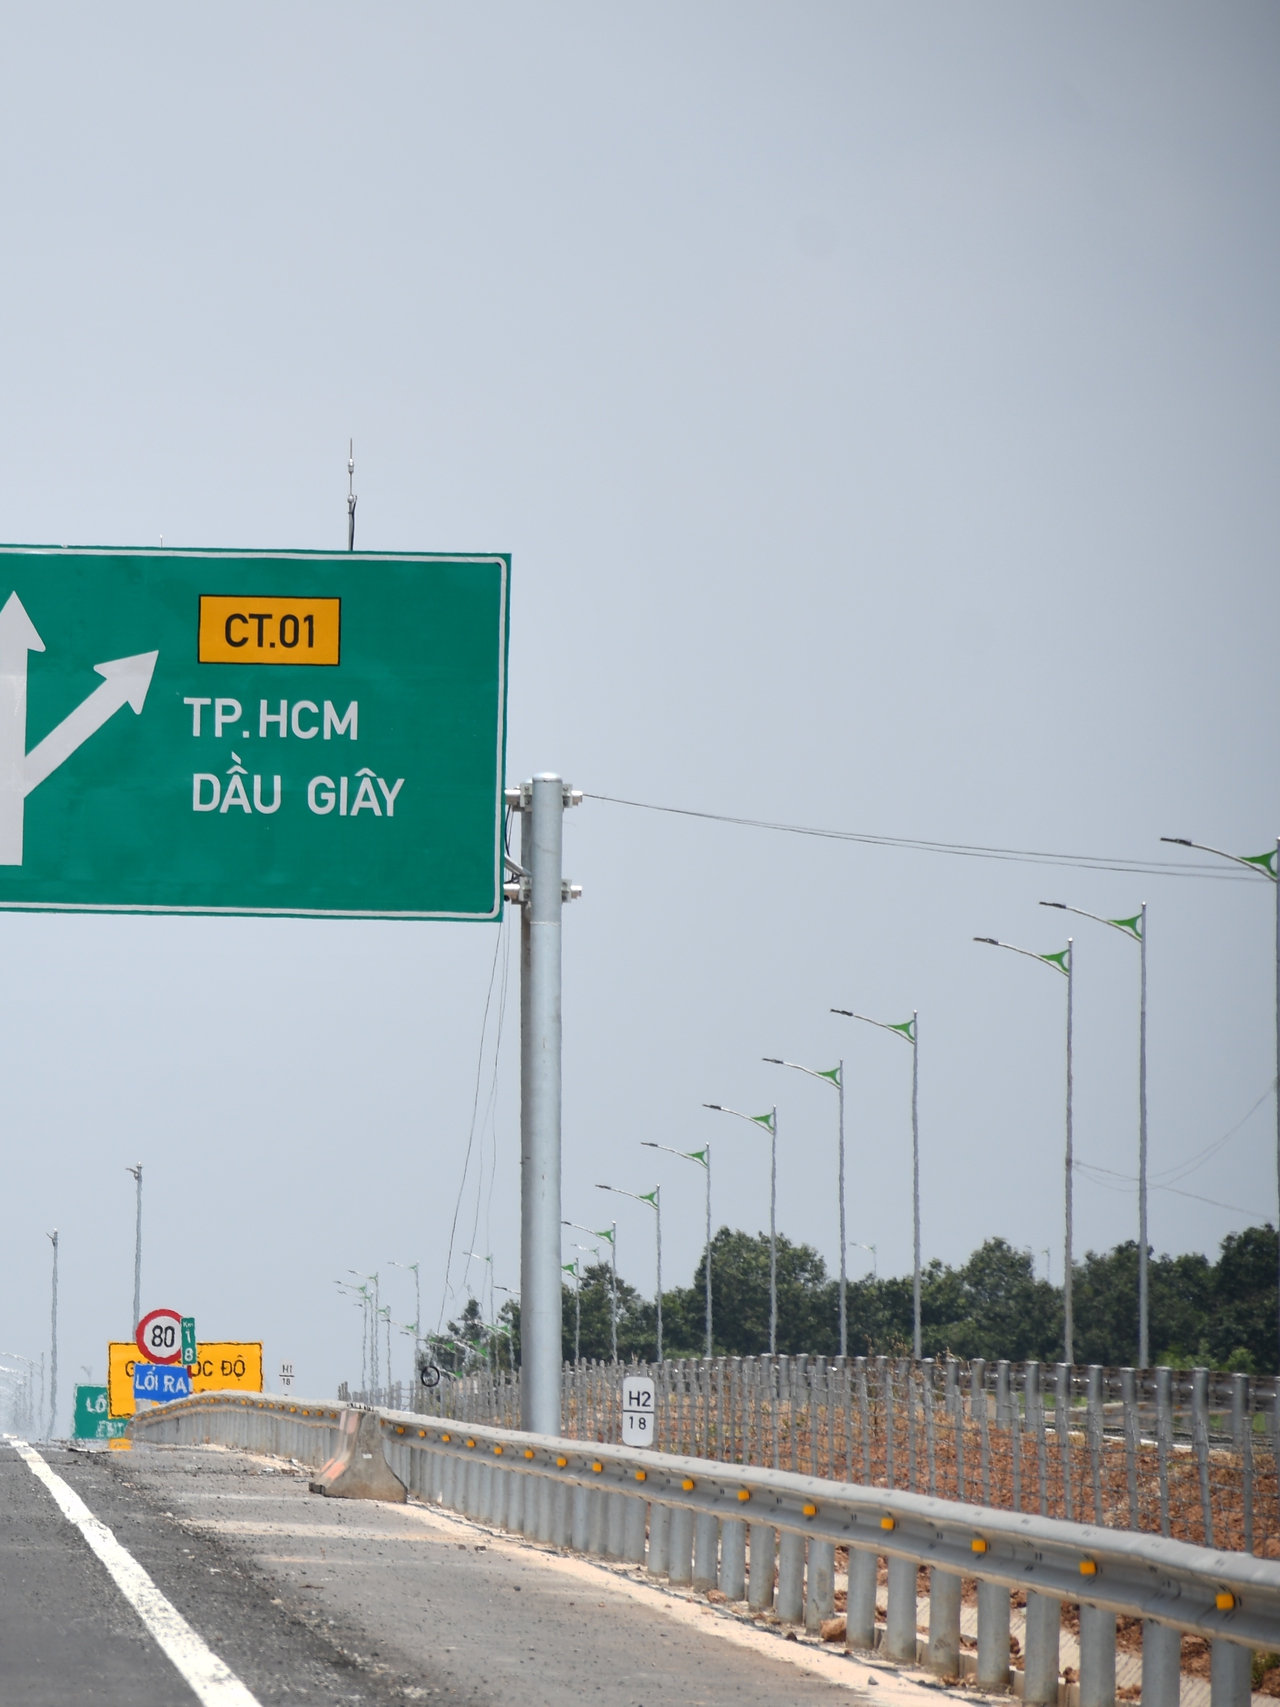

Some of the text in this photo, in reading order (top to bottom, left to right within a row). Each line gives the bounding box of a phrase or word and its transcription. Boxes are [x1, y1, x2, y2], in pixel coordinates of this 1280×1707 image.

[225, 613, 314, 648] CT.01
[183, 697, 358, 740] TP.HCM
[192, 751, 405, 817] DẦU GIÂY
[151, 1325, 175, 1348] 80
[135, 1366, 159, 1391] LỐI
[163, 1375, 188, 1393] RA
[221, 1355, 246, 1381] ĐỘ
[86, 1392, 107, 1414] LỐ
[628, 1390, 651, 1407] H2
[629, 1416, 647, 1430] 18
